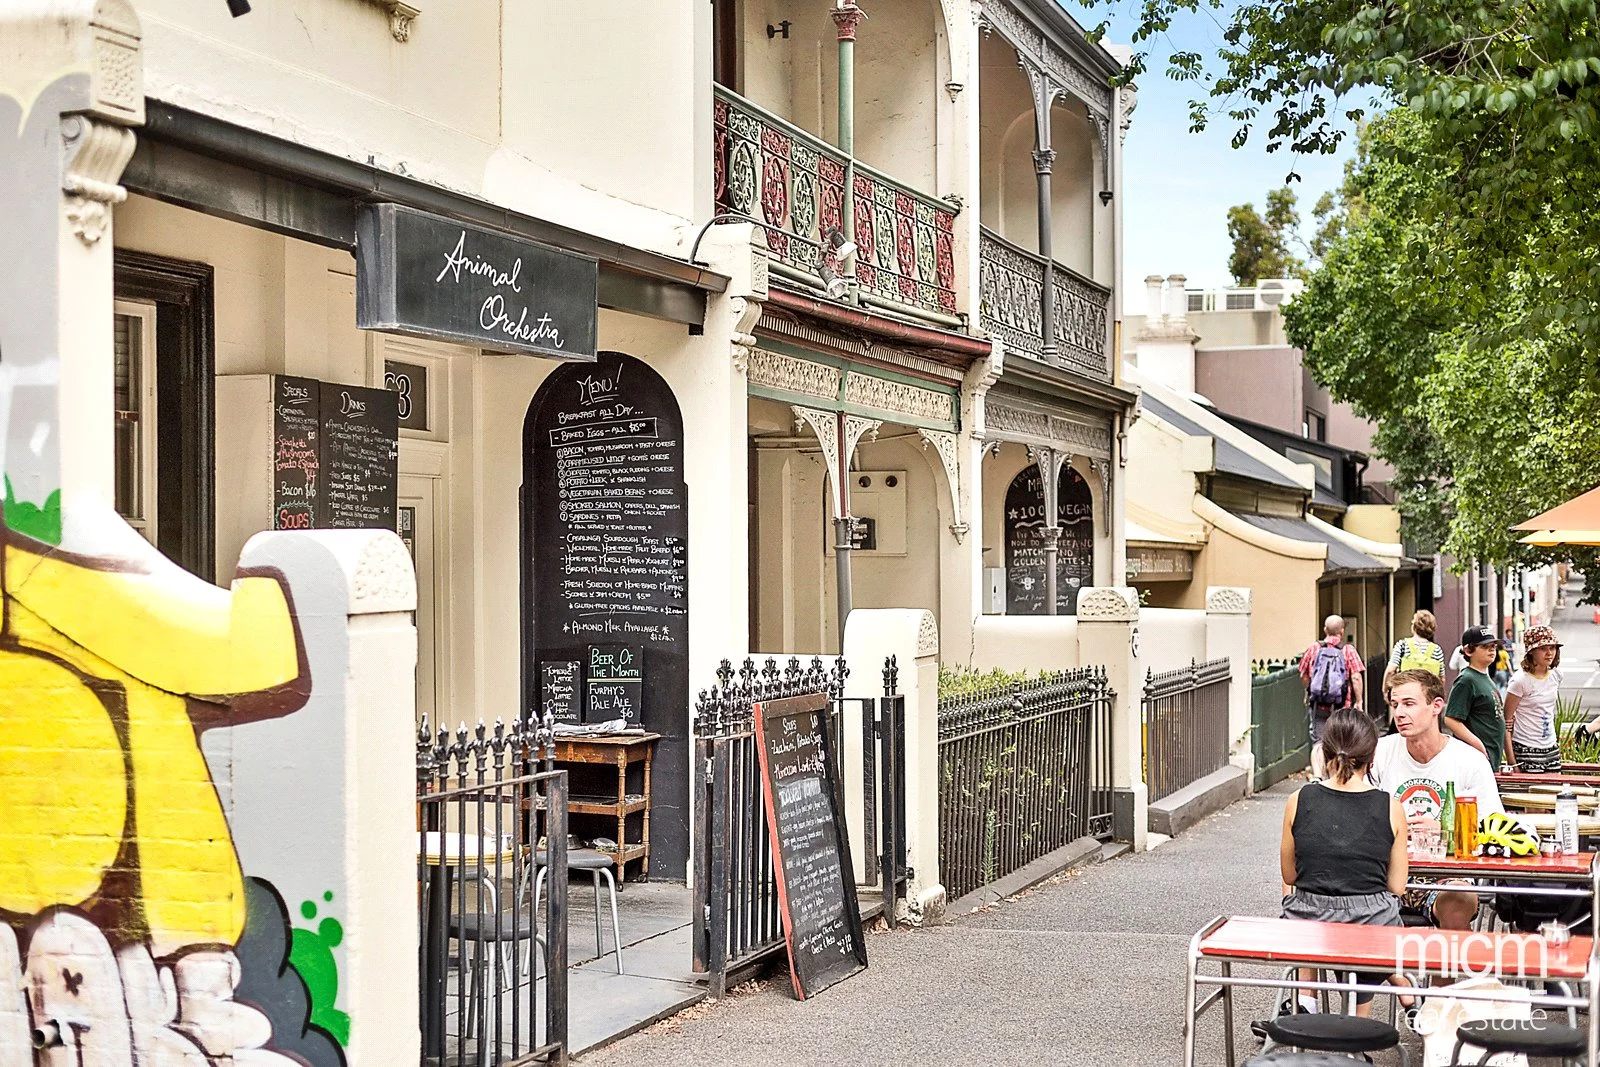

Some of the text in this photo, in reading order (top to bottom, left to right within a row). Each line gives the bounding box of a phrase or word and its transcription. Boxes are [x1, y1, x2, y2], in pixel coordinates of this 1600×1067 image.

[436, 230, 522, 293] Animal
[480, 294, 565, 349] Orchestra
[558, 409, 598, 425] BREAKFAST
[599, 408, 615, 418] ALL
[561, 426, 627, 442] BAKED EGGS ALL
[655, 440, 677, 448] CHEESE
[650, 453, 671, 461] CHEESE
[281, 480, 304, 497] Bacon
[603, 488, 625, 497] BAKED
[624, 487, 647, 497] BEANS
[567, 501, 595, 511] SMOKED
[1058, 503, 1092, 516] VEGAN
[280, 509, 309, 530] SOUPS
[568, 513, 600, 523] SARDINES
[603, 533, 639, 543] SOURDOUGH
[641, 535, 660, 545] TOAST
[635, 544, 650, 553] FRUIT
[650, 544, 671, 554] BREAD
[1013, 557, 1047, 567] GOLDEN
[564, 579, 584, 589] FRESH
[572, 620, 604, 635] ALMOND
[592, 648, 634, 665] BEER OF
[590, 665, 639, 678] THE MONTH
[589, 682, 625, 695] FURPHY'S
[590, 695, 632, 711] PALE ALE
[620, 707, 634, 720] $6
[1403, 779, 1441, 792] HOKKAIDO
